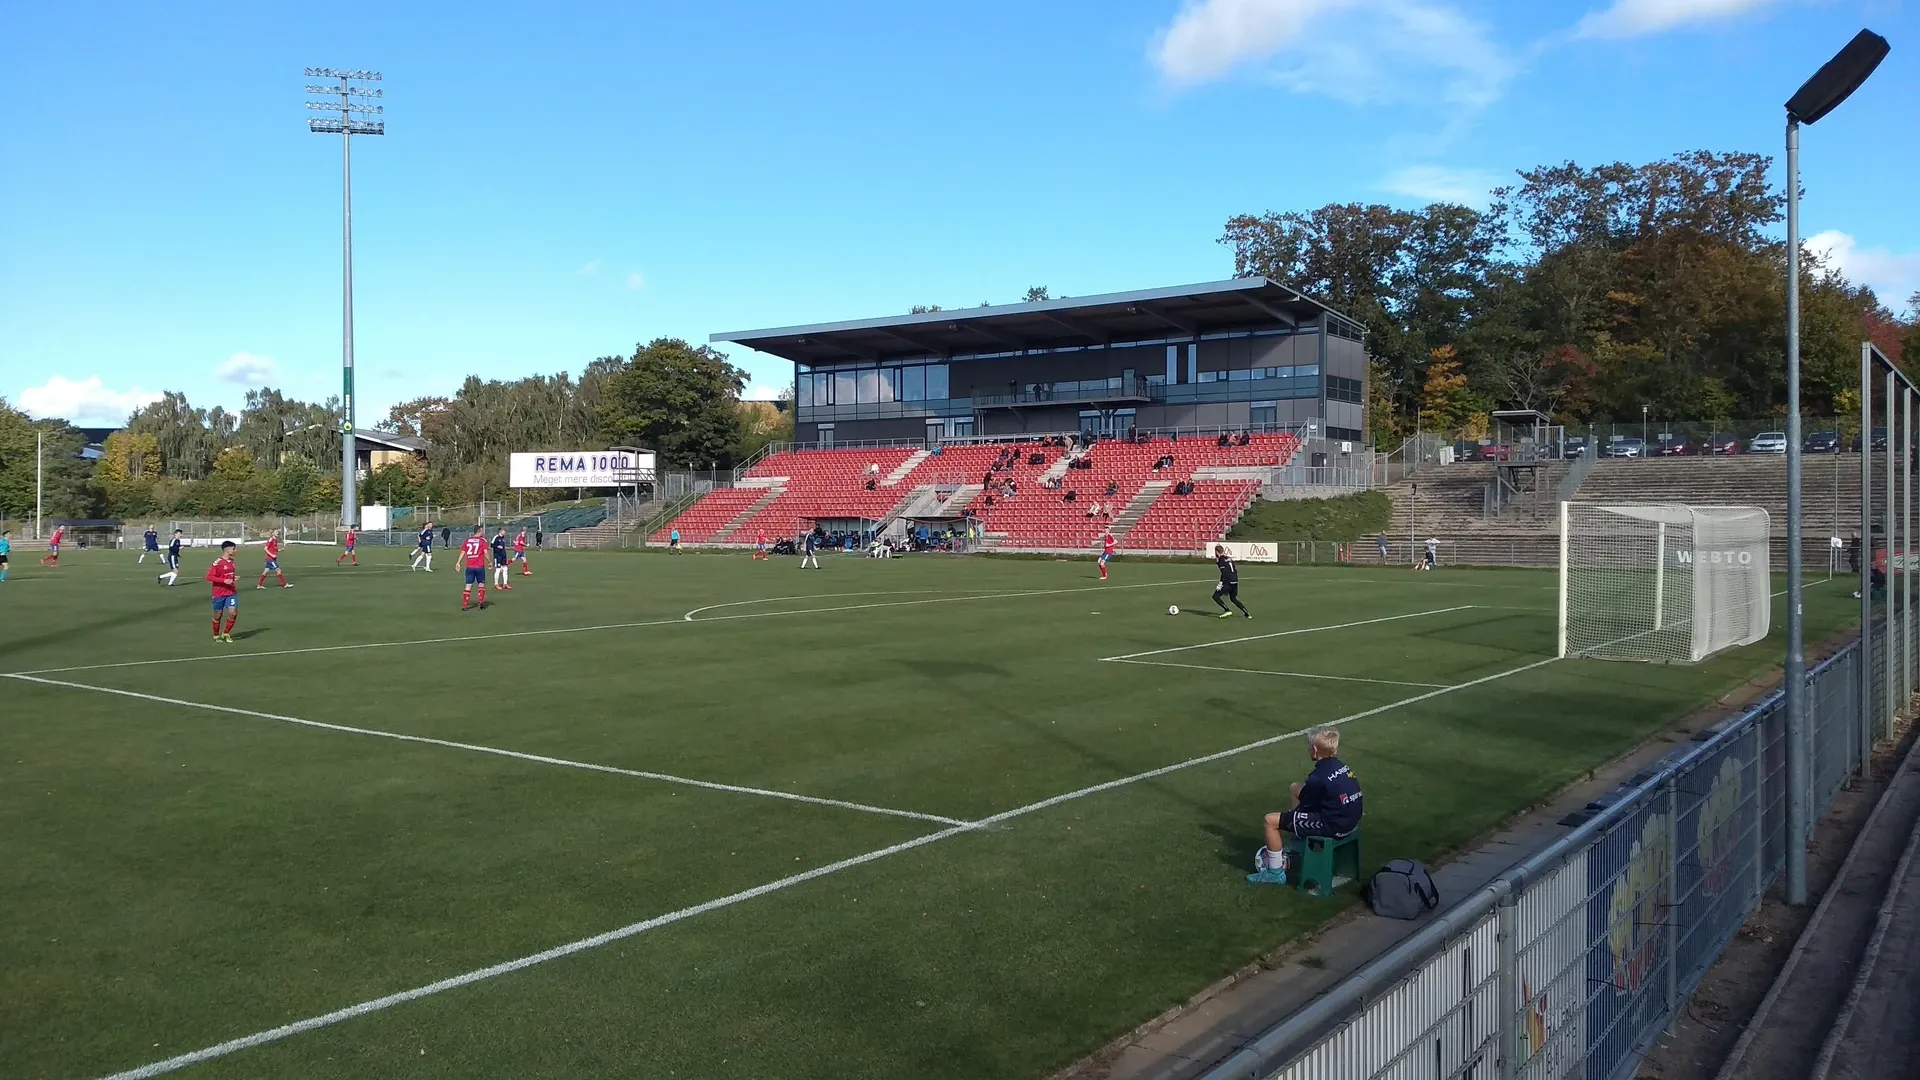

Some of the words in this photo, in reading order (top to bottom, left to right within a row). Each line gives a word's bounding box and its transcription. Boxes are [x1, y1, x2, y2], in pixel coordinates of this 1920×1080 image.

[535, 457, 585, 471] REMA
[592, 456, 629, 470] 1000
[534, 475, 562, 486] Meget
[466, 543, 479, 555] 27
[1677, 550, 1752, 564] WEBTO
